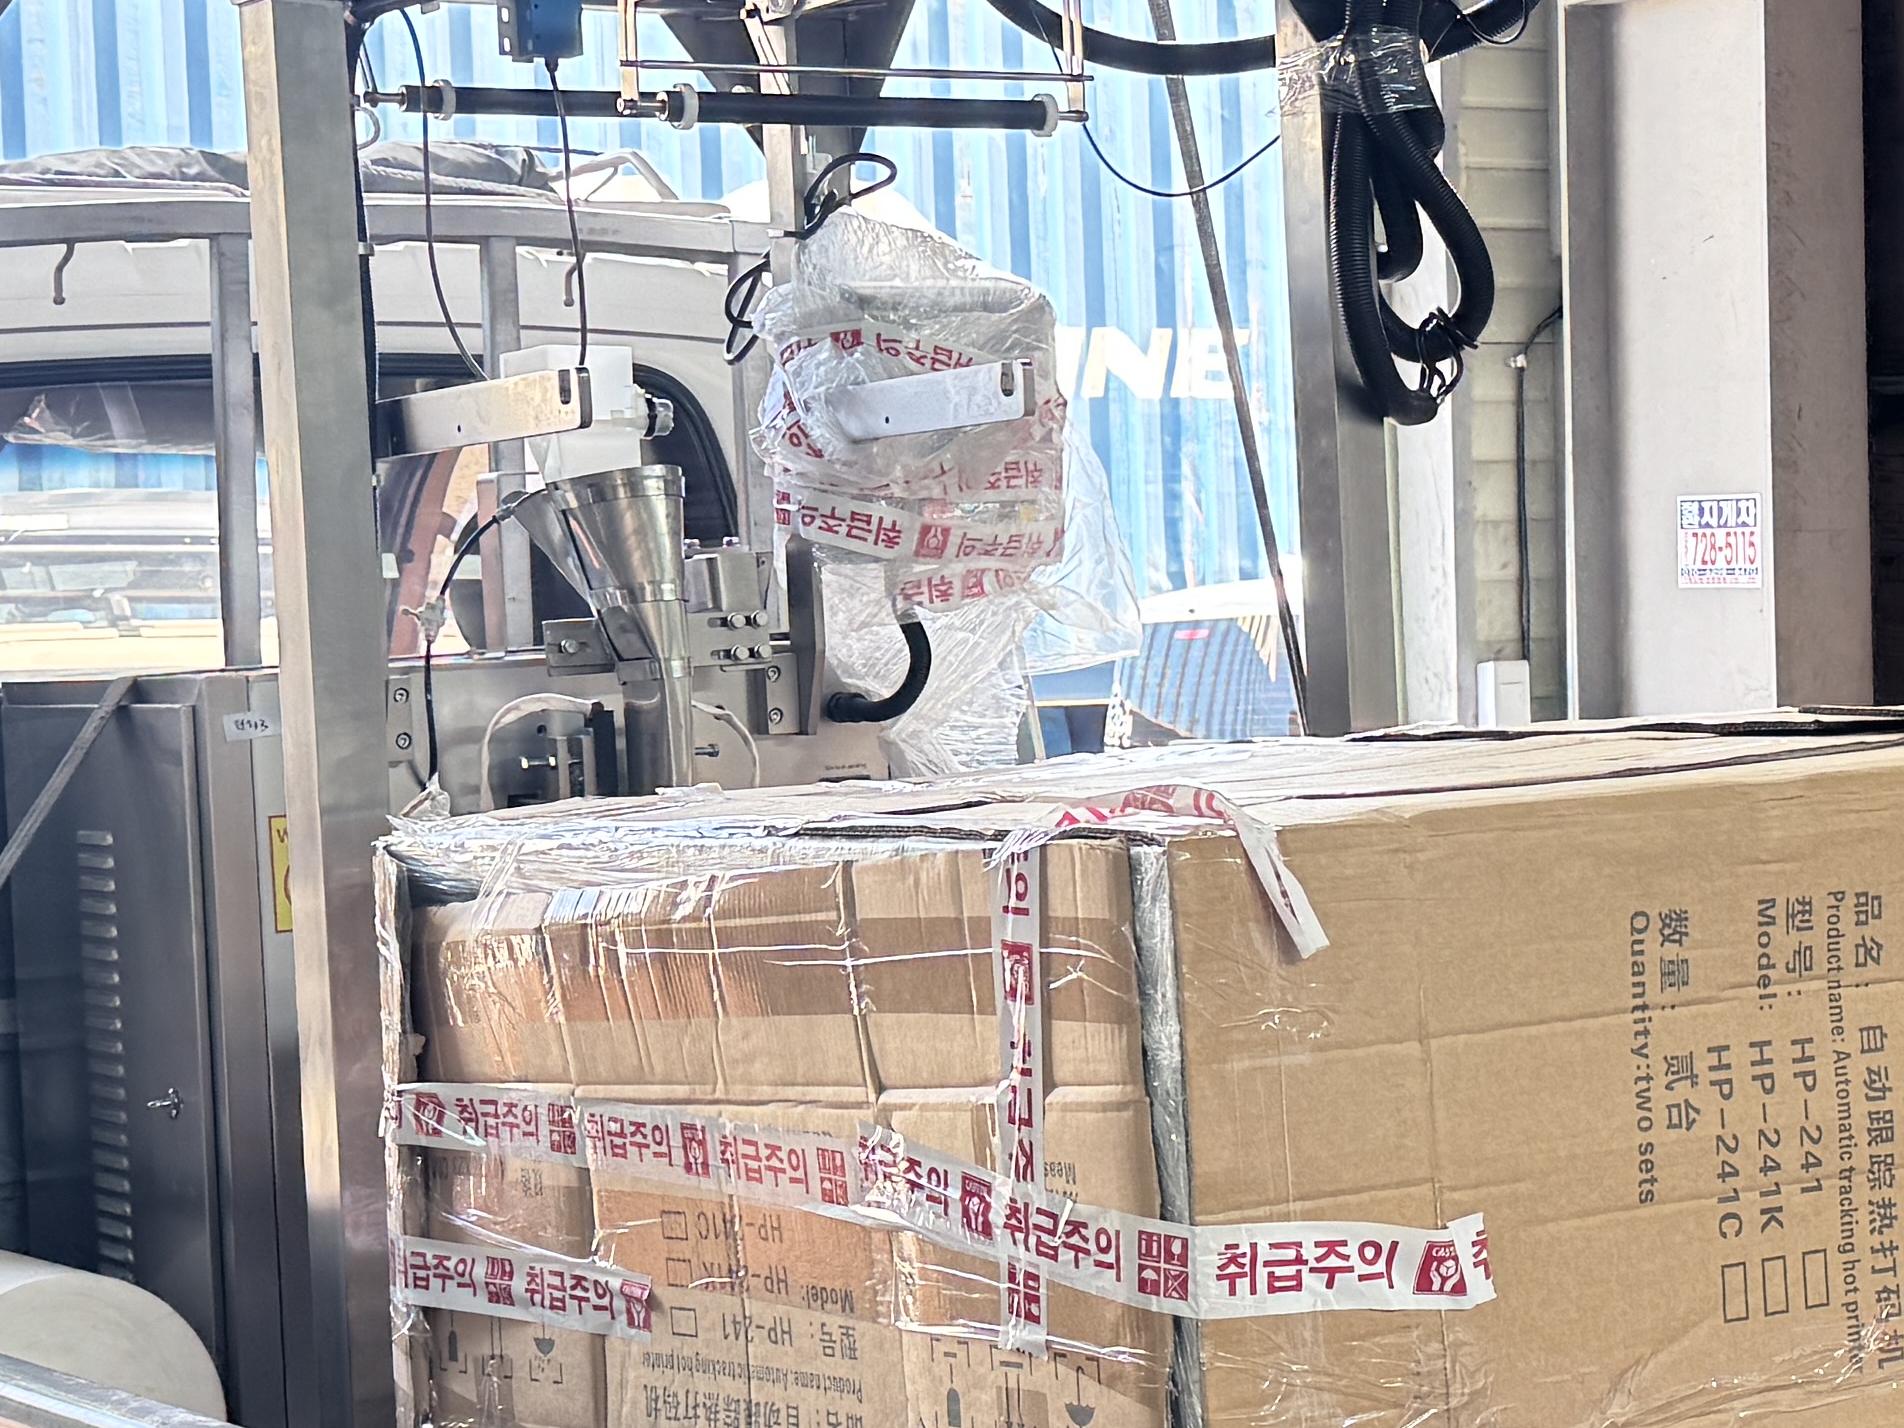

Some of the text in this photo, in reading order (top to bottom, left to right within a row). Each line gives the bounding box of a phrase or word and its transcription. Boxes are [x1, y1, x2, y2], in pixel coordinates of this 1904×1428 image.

[800, 506, 902, 549] 취급주의
[1700, 499, 1756, 528] 지게차
[1692, 531, 1757, 565] 728-5115
[1826, 890, 1846, 974] Product
[1828, 978, 1850, 1045] name:
[1663, 1052, 1700, 1133] 贰台
[1748, 897, 1785, 1235] Model: HP-241K
[1791, 1036, 1825, 1197] HP-241
[1832, 1049, 1858, 1163] Automatic
[719, 1133, 810, 1195] 취급주의
[1706, 1044, 1743, 1240] HP-241C
[1638, 1142, 1660, 1205] sets
[1835, 1166, 1861, 1255] tracking
[1003, 1196, 1122, 1282] 취급주의
[1216, 1239, 1400, 1297] 취급주의
[524, 1265, 616, 1320] 취급주의
[801, 1284, 855, 1314] Model:
[1841, 1259, 1862, 1296] hot
[720, 1312, 793, 1347] HP-241
[642, 1349, 675, 1372] printer
[676, 1354, 694, 1373] hot
[694, 1352, 736, 1381] tracking
[790, 1369, 821, 1393] name:
[822, 1374, 863, 1404] Product
